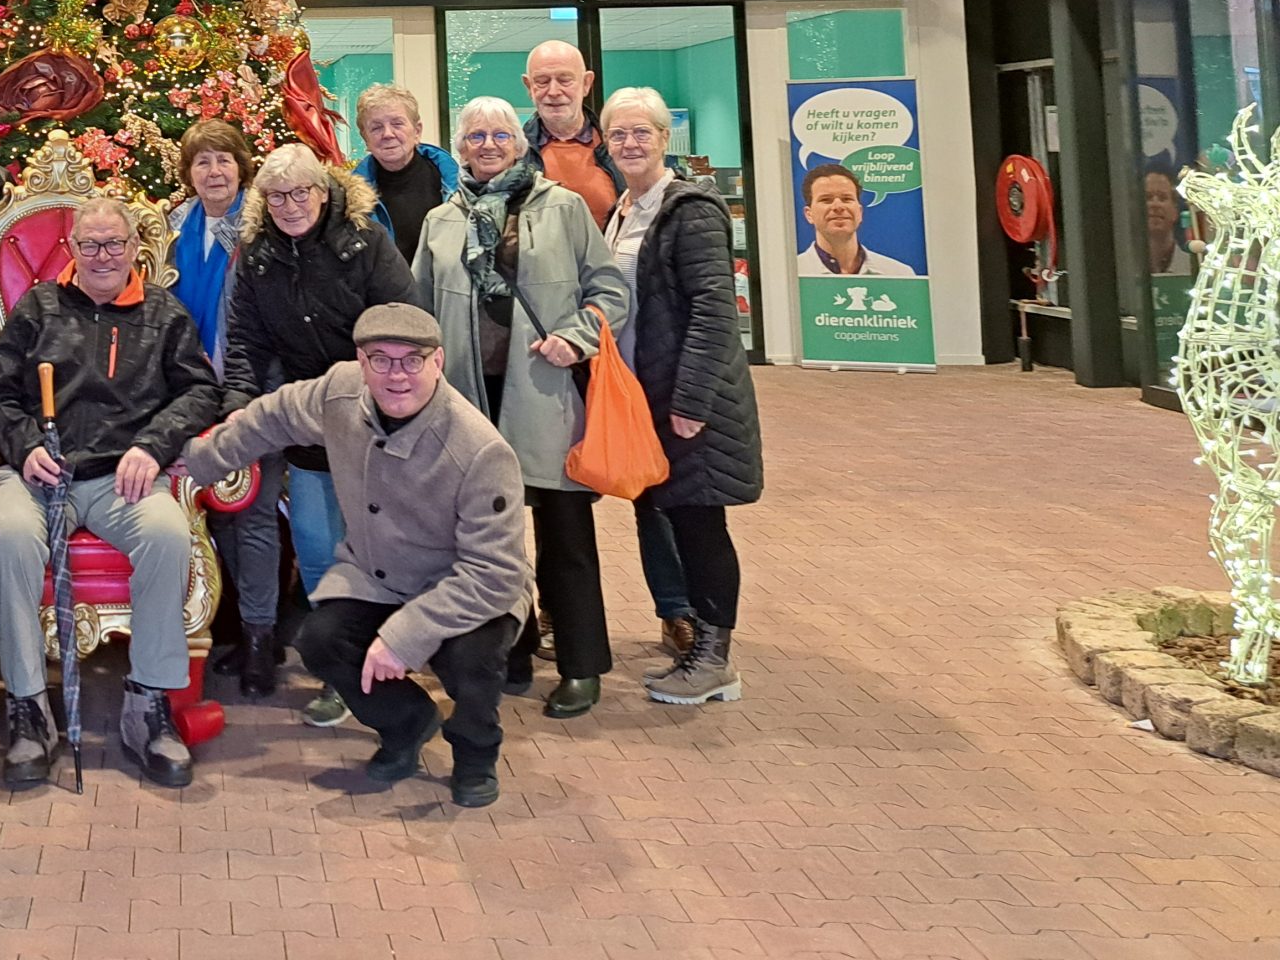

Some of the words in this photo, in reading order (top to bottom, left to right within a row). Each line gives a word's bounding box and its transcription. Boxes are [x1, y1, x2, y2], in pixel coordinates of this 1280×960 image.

[807, 109, 840, 119] Heeft
[842, 111, 850, 119] u
[853, 109, 897, 120] vragen
[806, 120, 819, 131] of
[821, 121, 843, 130] wilt
[846, 122, 854, 130] u
[856, 120, 899, 130] komen
[832, 132, 876, 144] kijken?
[868, 152, 895, 161] Loop
[852, 162, 914, 173] vrijblijvend
[864, 174, 905, 183] binnen!
[815, 313, 918, 329] dierenkliniek
[834, 331, 900, 342] coppelmans
